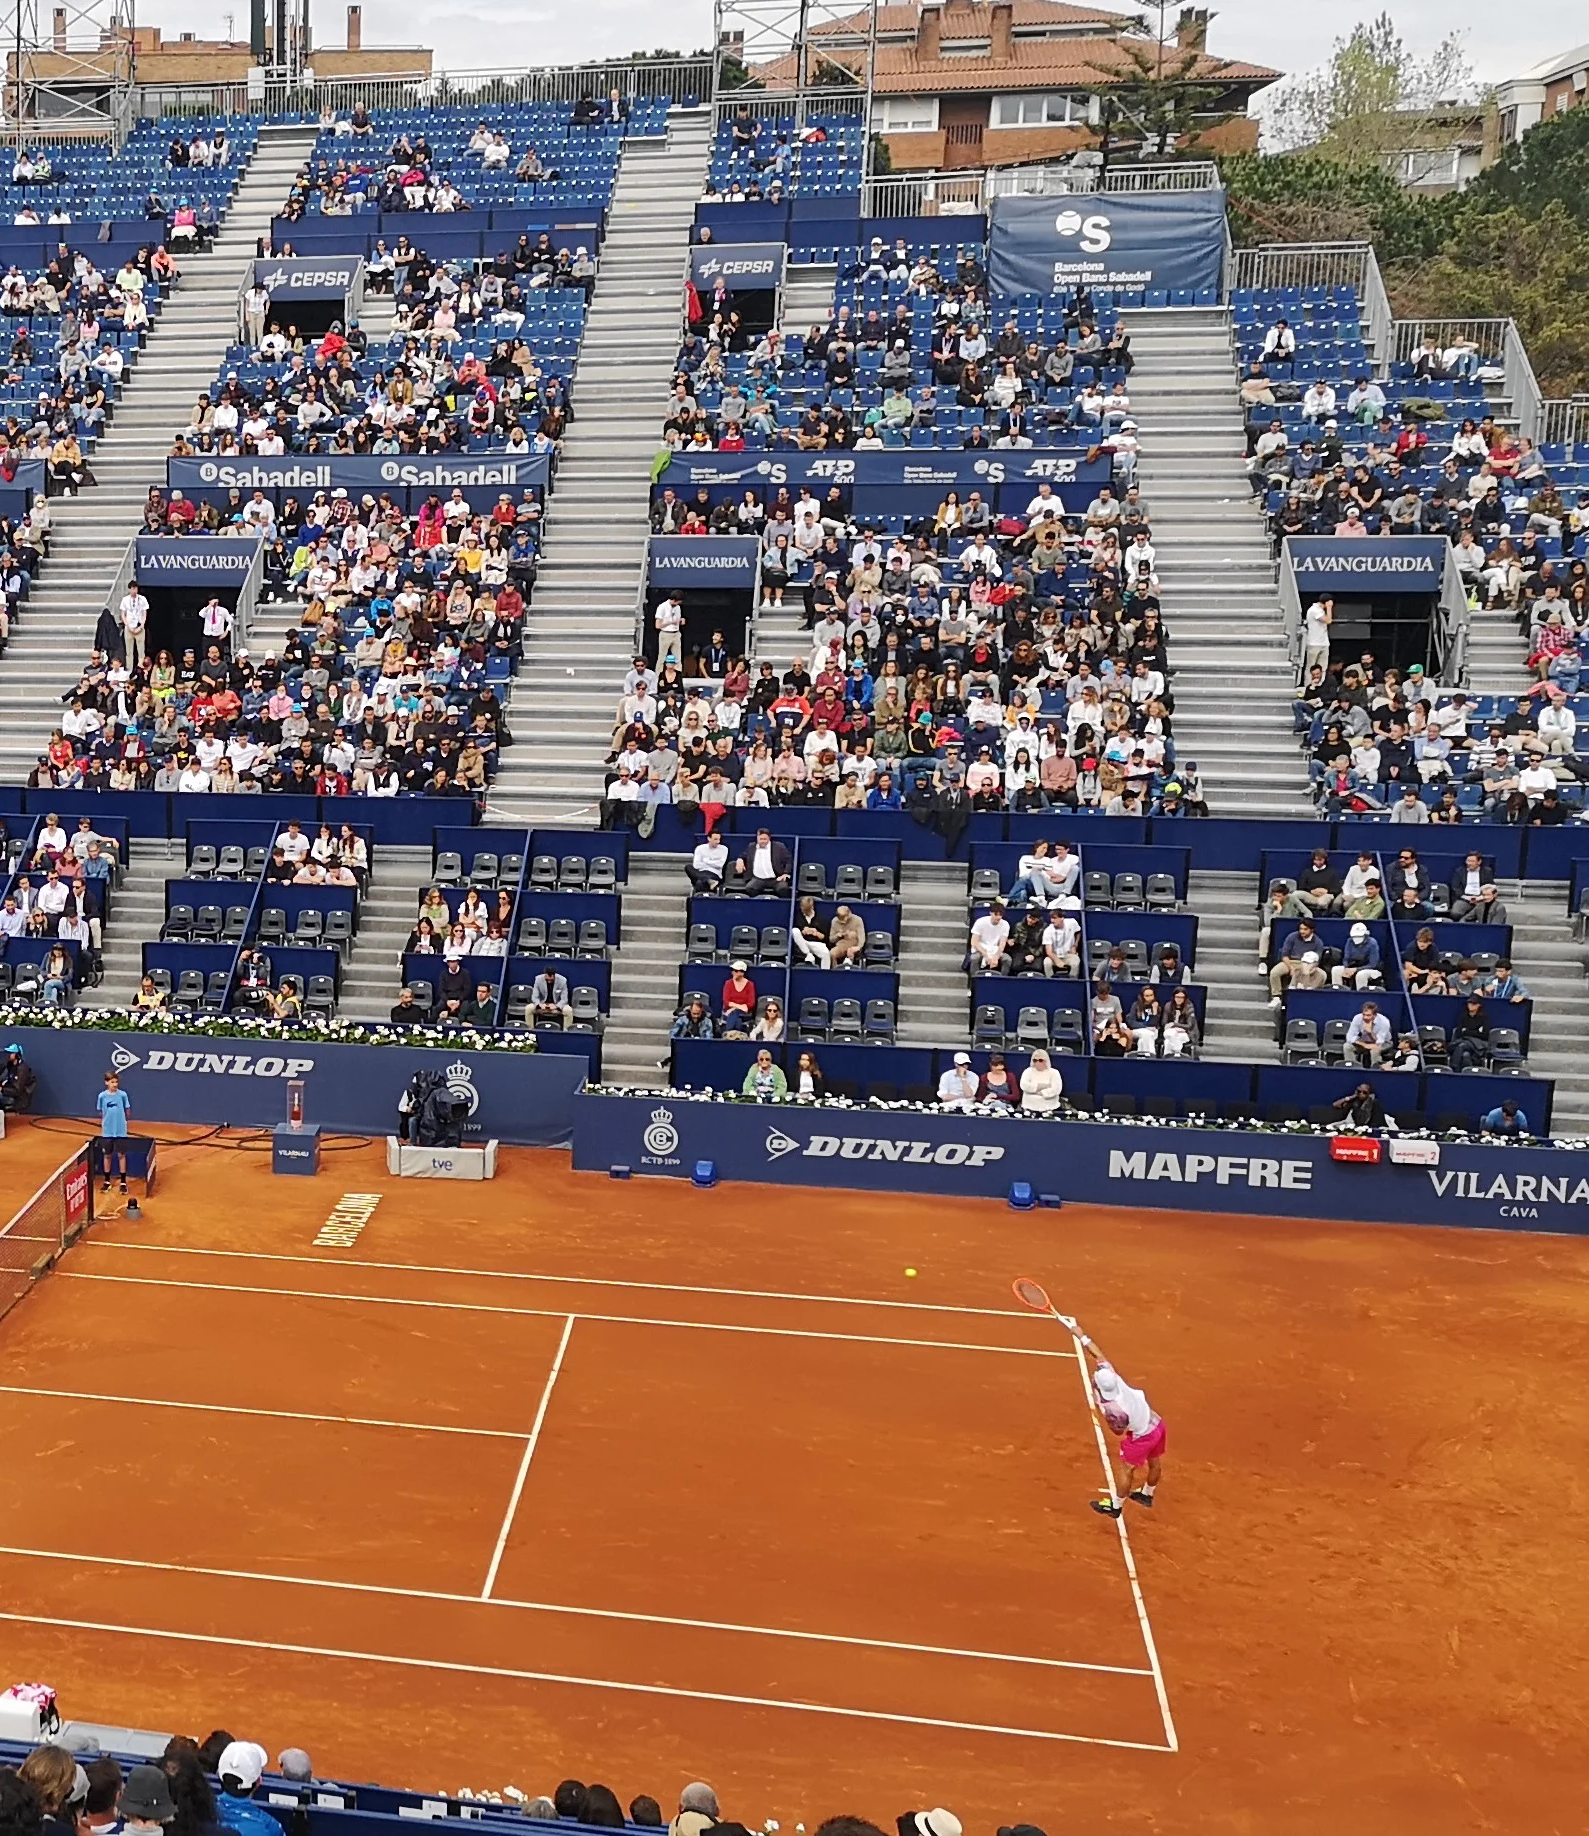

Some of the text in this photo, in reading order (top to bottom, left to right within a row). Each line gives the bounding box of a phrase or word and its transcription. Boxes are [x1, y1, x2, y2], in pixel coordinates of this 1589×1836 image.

[723, 260, 774, 275] CEPSA
[1054, 261, 1104, 272] Barcelona
[290, 271, 350, 287] CEPSA
[1054, 270, 1152, 285] Open Banc Sabadell
[401, 465, 517, 485] Sabadell
[806, 460, 856, 477] ATP
[1023, 459, 1077, 476] ATP
[219, 466, 331, 487] Sabadell
[141, 555, 252, 569] LA VANGUARDIA
[655, 556, 750, 568] LA VANGUARDIA
[1293, 556, 1435, 572] LA VANGUARDIA
[142, 1050, 315, 1078] DUNLOP
[802, 1135, 1005, 1167] DUNLOP
[432, 1158, 453, 1171] tve
[1109, 1150, 1313, 1190] MAPFRE
[312, 1193, 383, 1247] BARCELONA
[1500, 1206, 1539, 1218] CAVA
